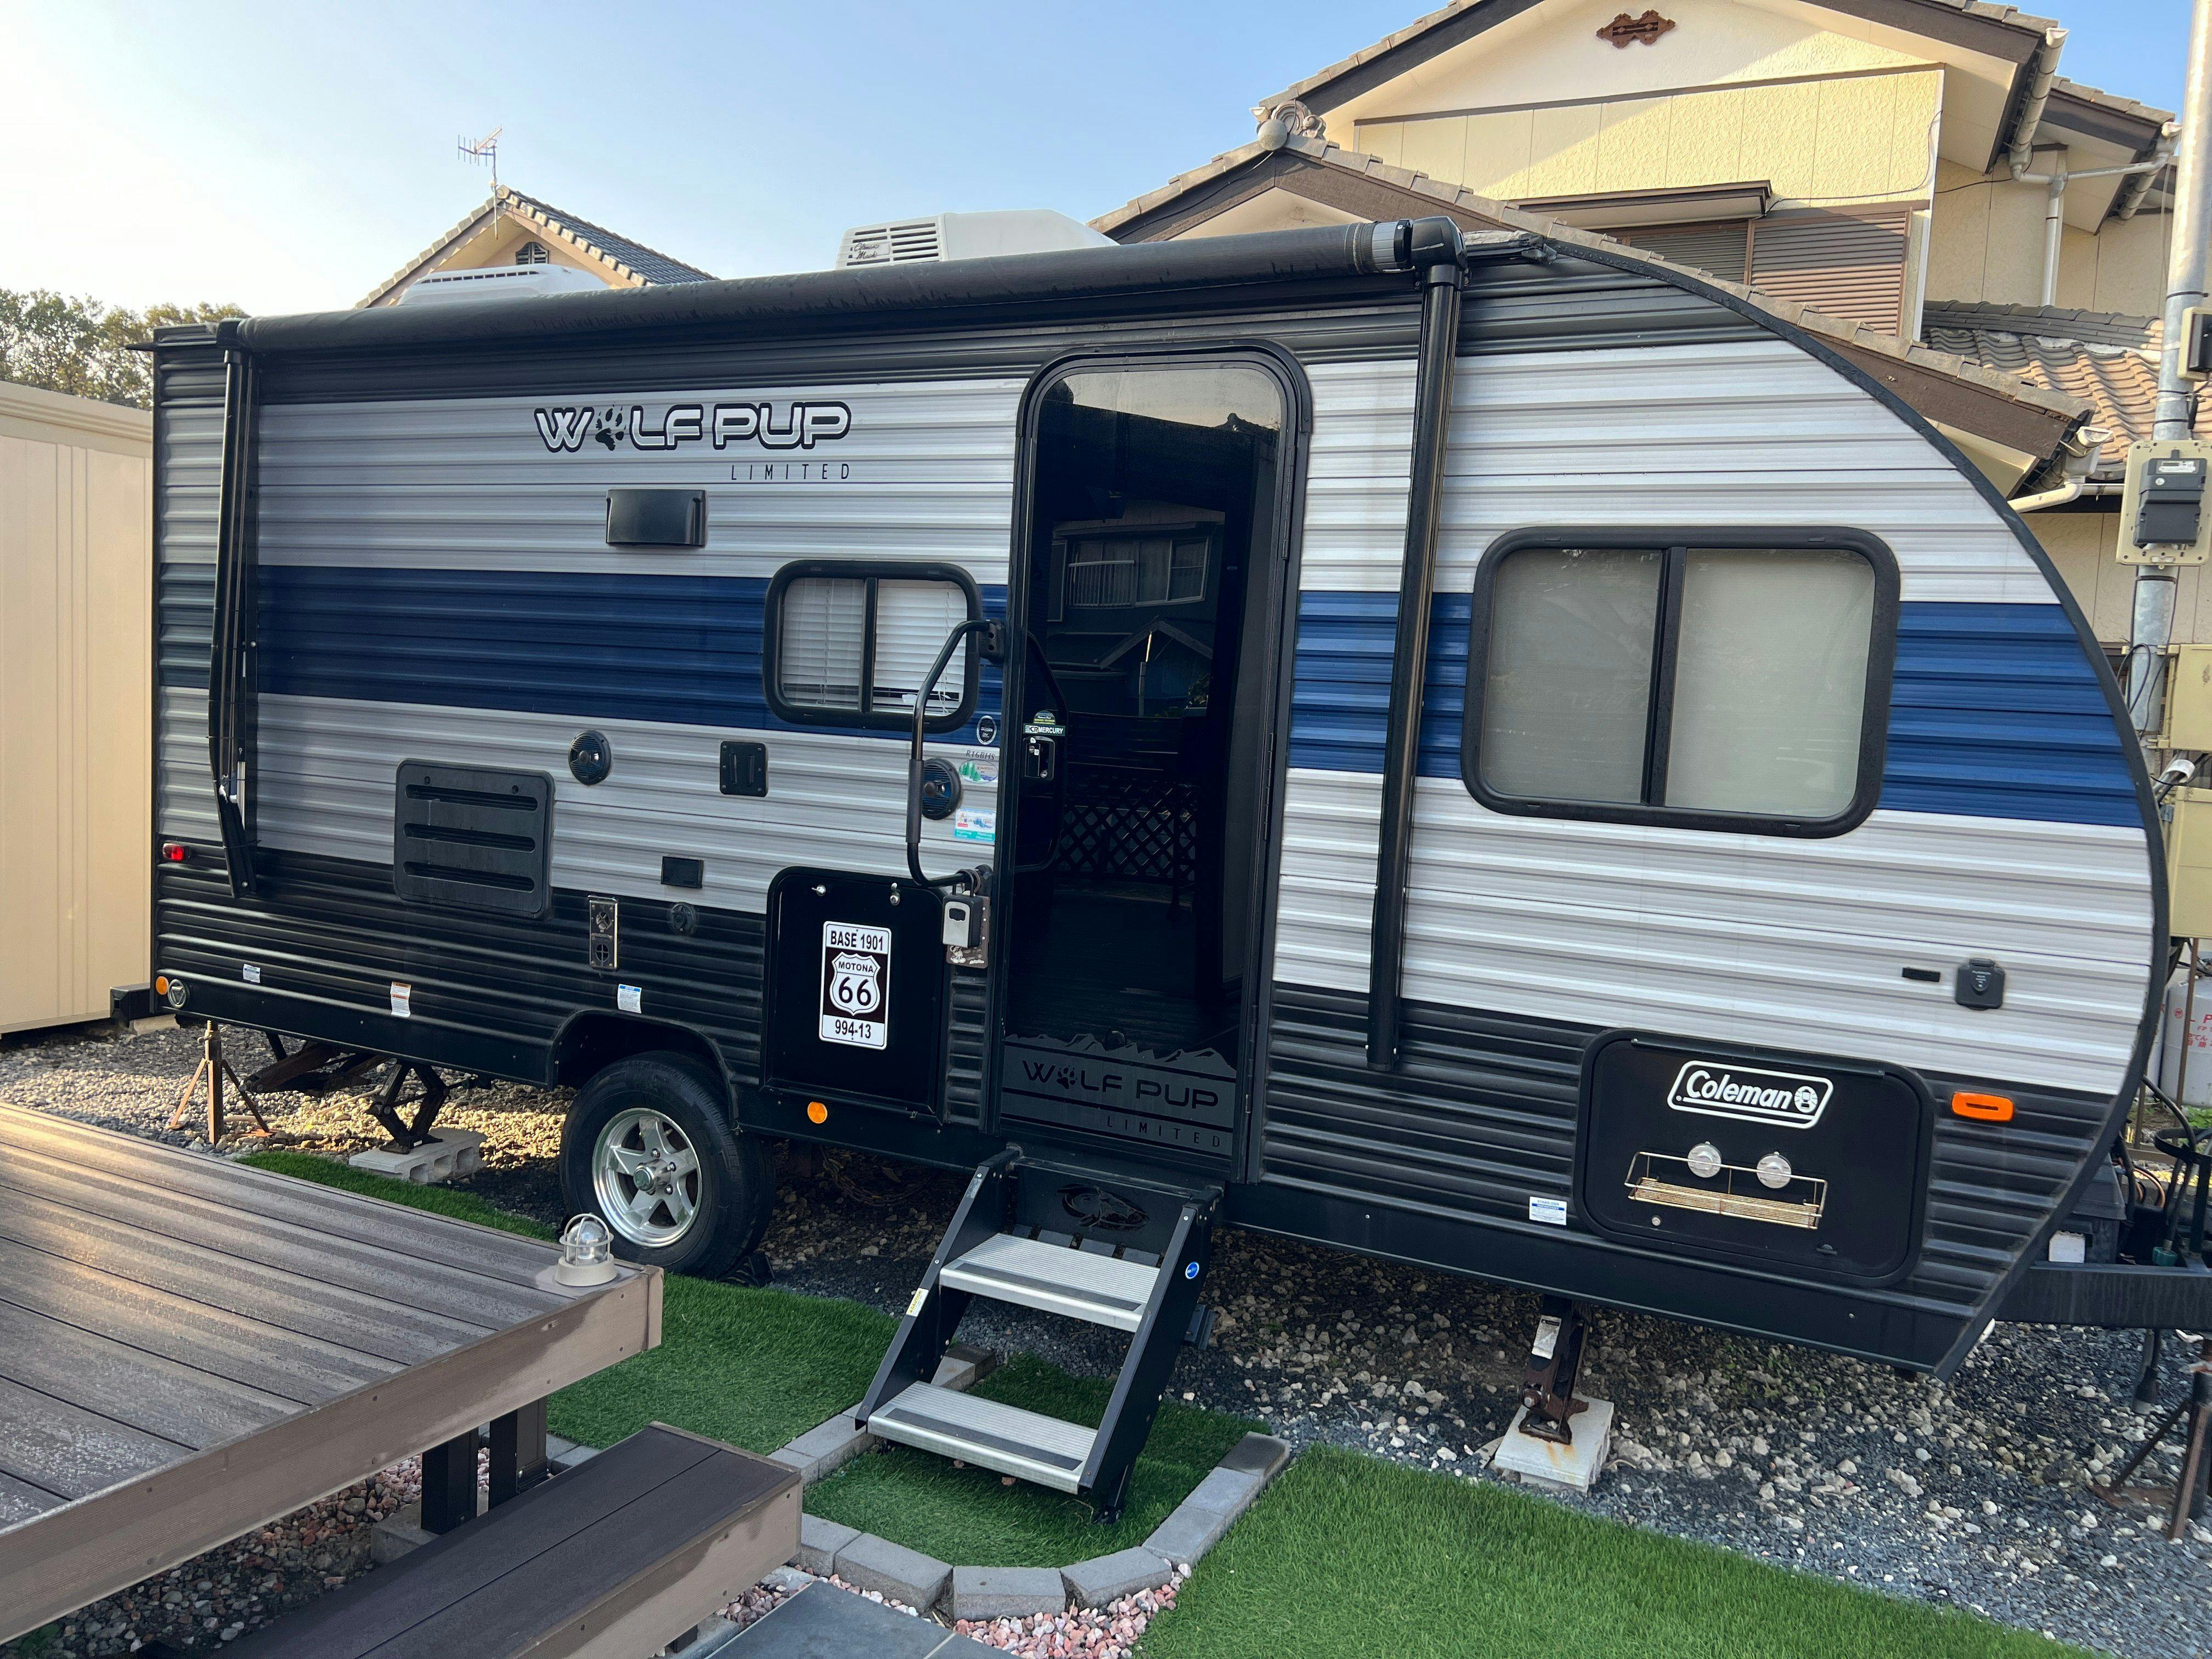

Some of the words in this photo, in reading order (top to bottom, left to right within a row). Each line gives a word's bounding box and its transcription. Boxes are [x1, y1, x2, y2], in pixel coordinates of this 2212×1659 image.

[713, 402, 851, 449] PUP
[731, 463, 850, 481] LIMITED
[830, 930, 857, 948] BASE
[860, 934, 884, 951] 1901
[838, 961, 874, 973] MOTONA
[838, 977, 872, 1007] 66
[834, 1019, 872, 1039] 994-13
[1136, 1079, 1218, 1109] PUP
[1686, 1070, 1794, 1110] Coleman
[1107, 1115, 1220, 1147] LIMITED
